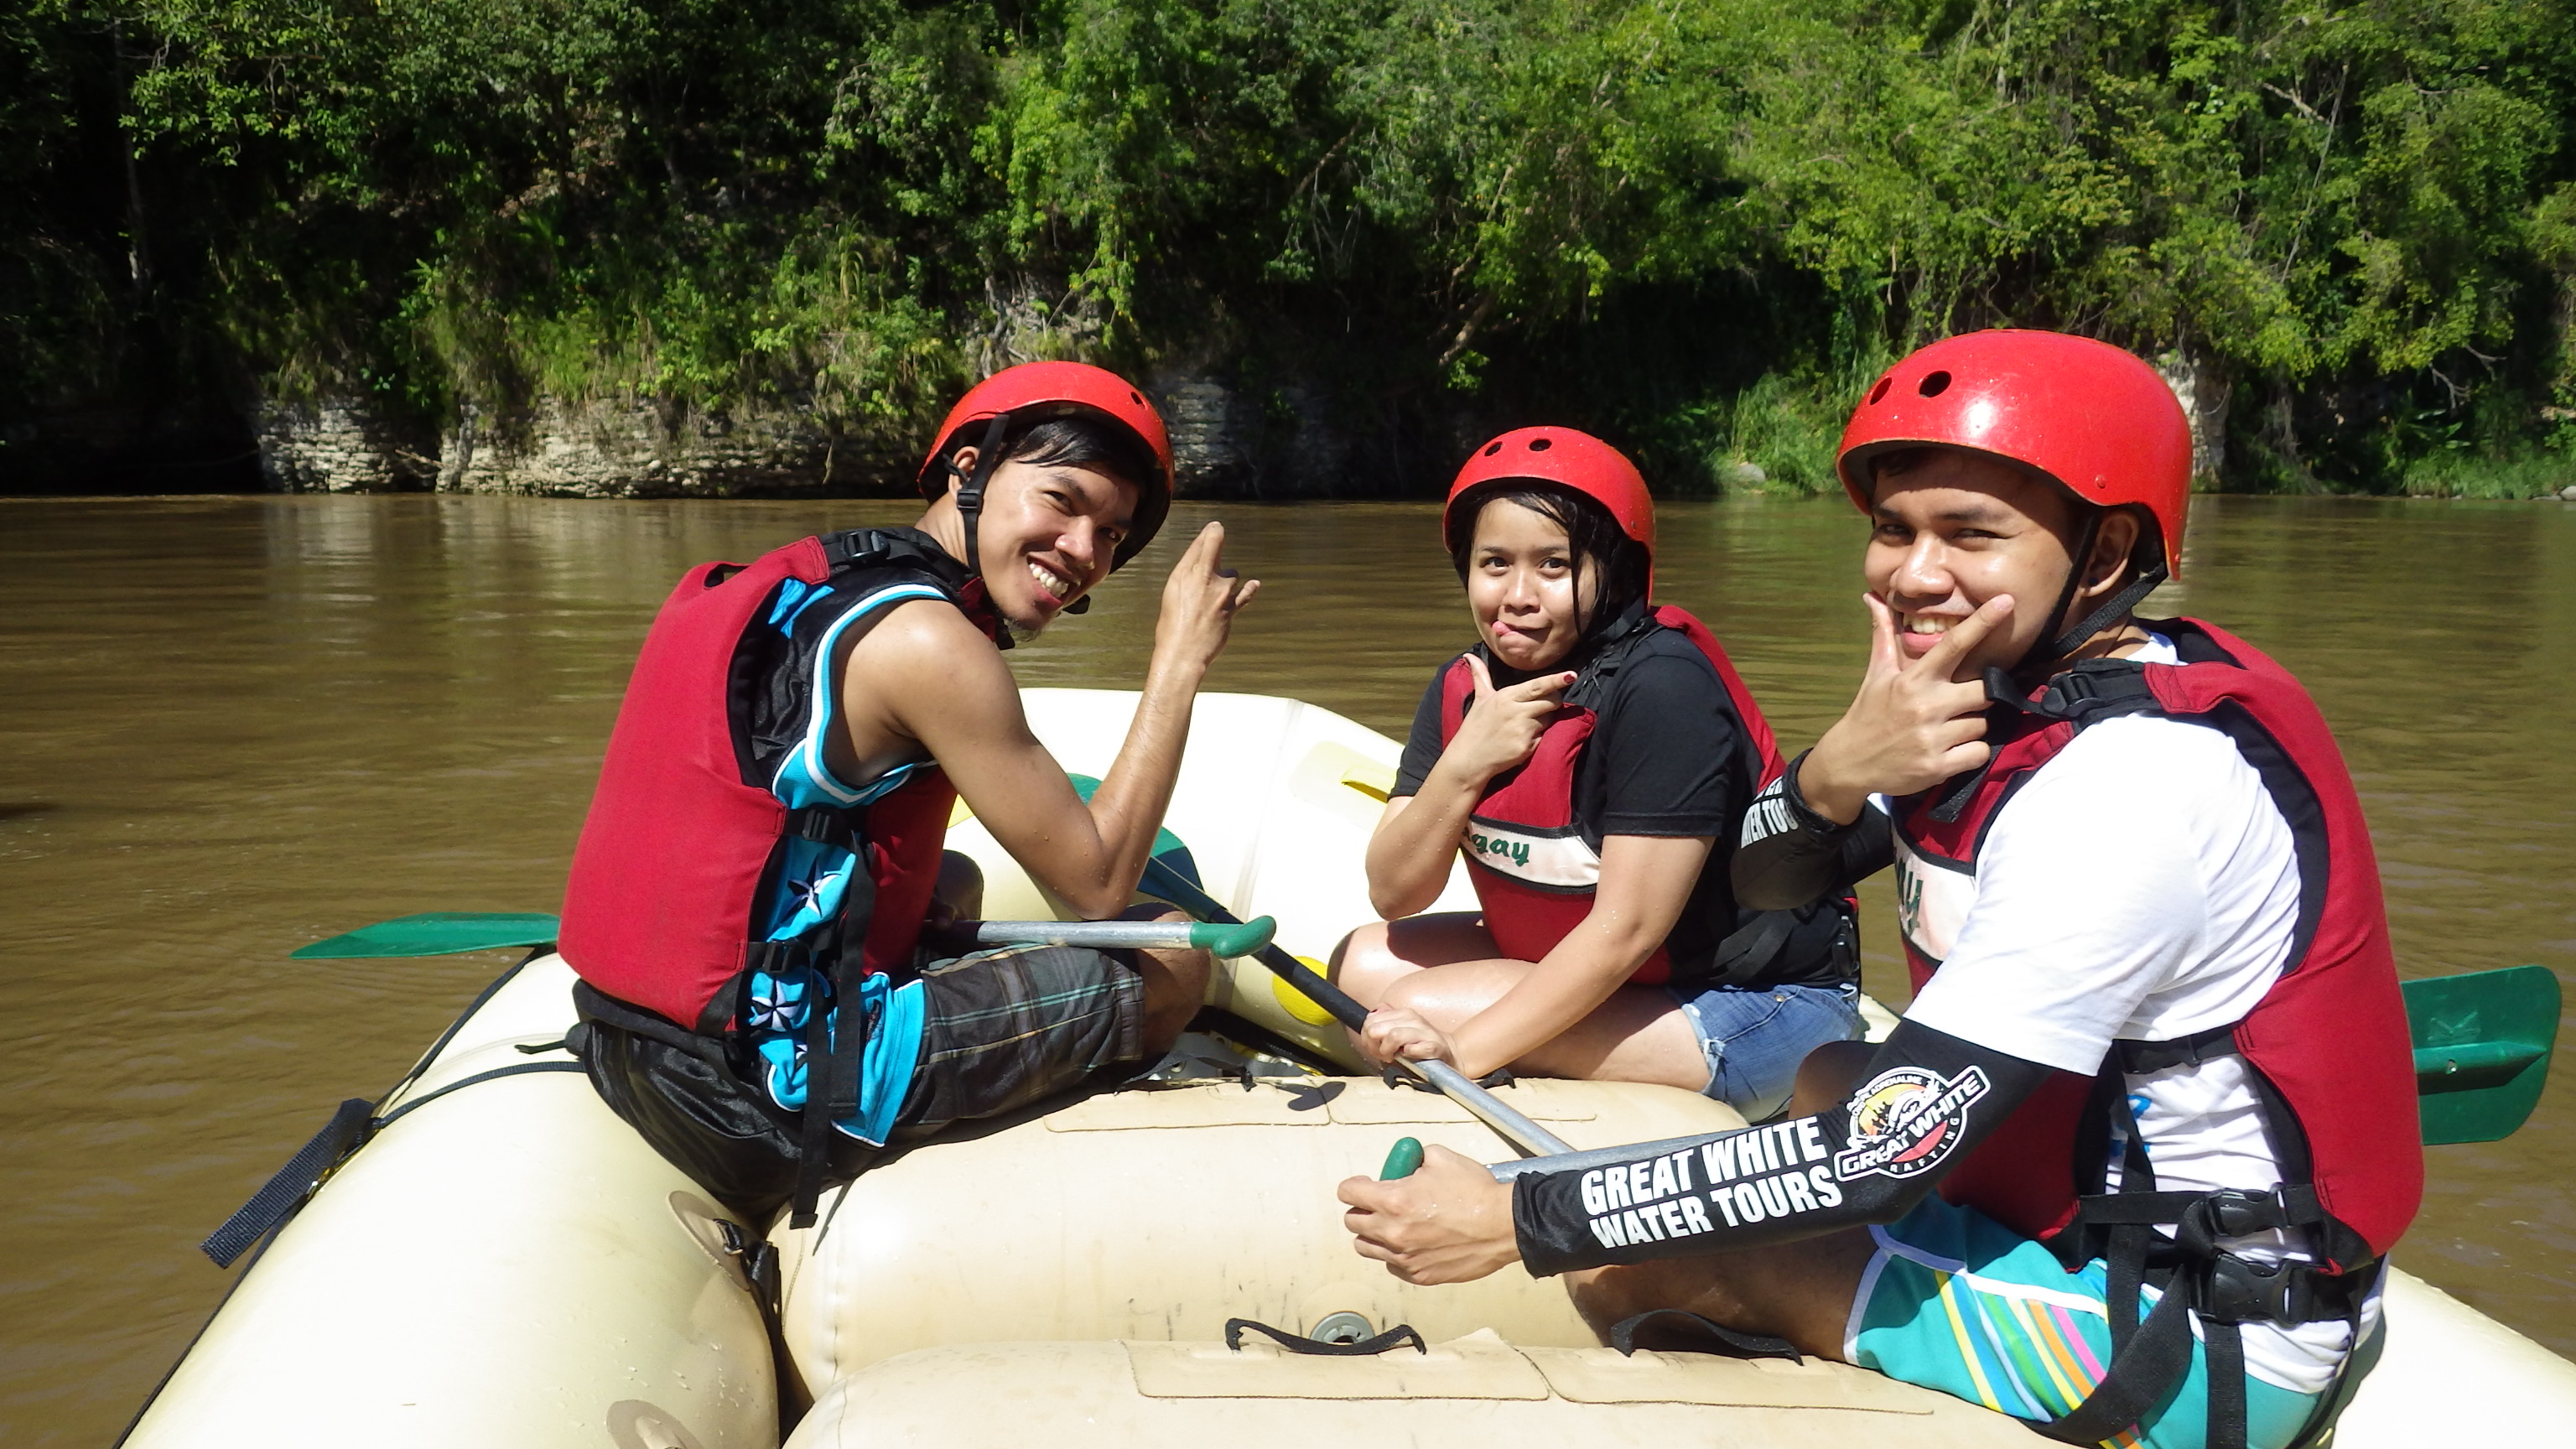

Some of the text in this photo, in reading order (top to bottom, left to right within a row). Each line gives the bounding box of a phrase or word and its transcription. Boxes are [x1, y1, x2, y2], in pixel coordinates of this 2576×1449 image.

[1581, 1116, 1827, 1216] GREAT WHITE
[1842, 1130, 1911, 1174] GREAT
[1908, 1074, 1981, 1138] WHITE
[1890, 1117, 1960, 1172] RAFTING
[1589, 1165, 1843, 1249] WATER TOURS
